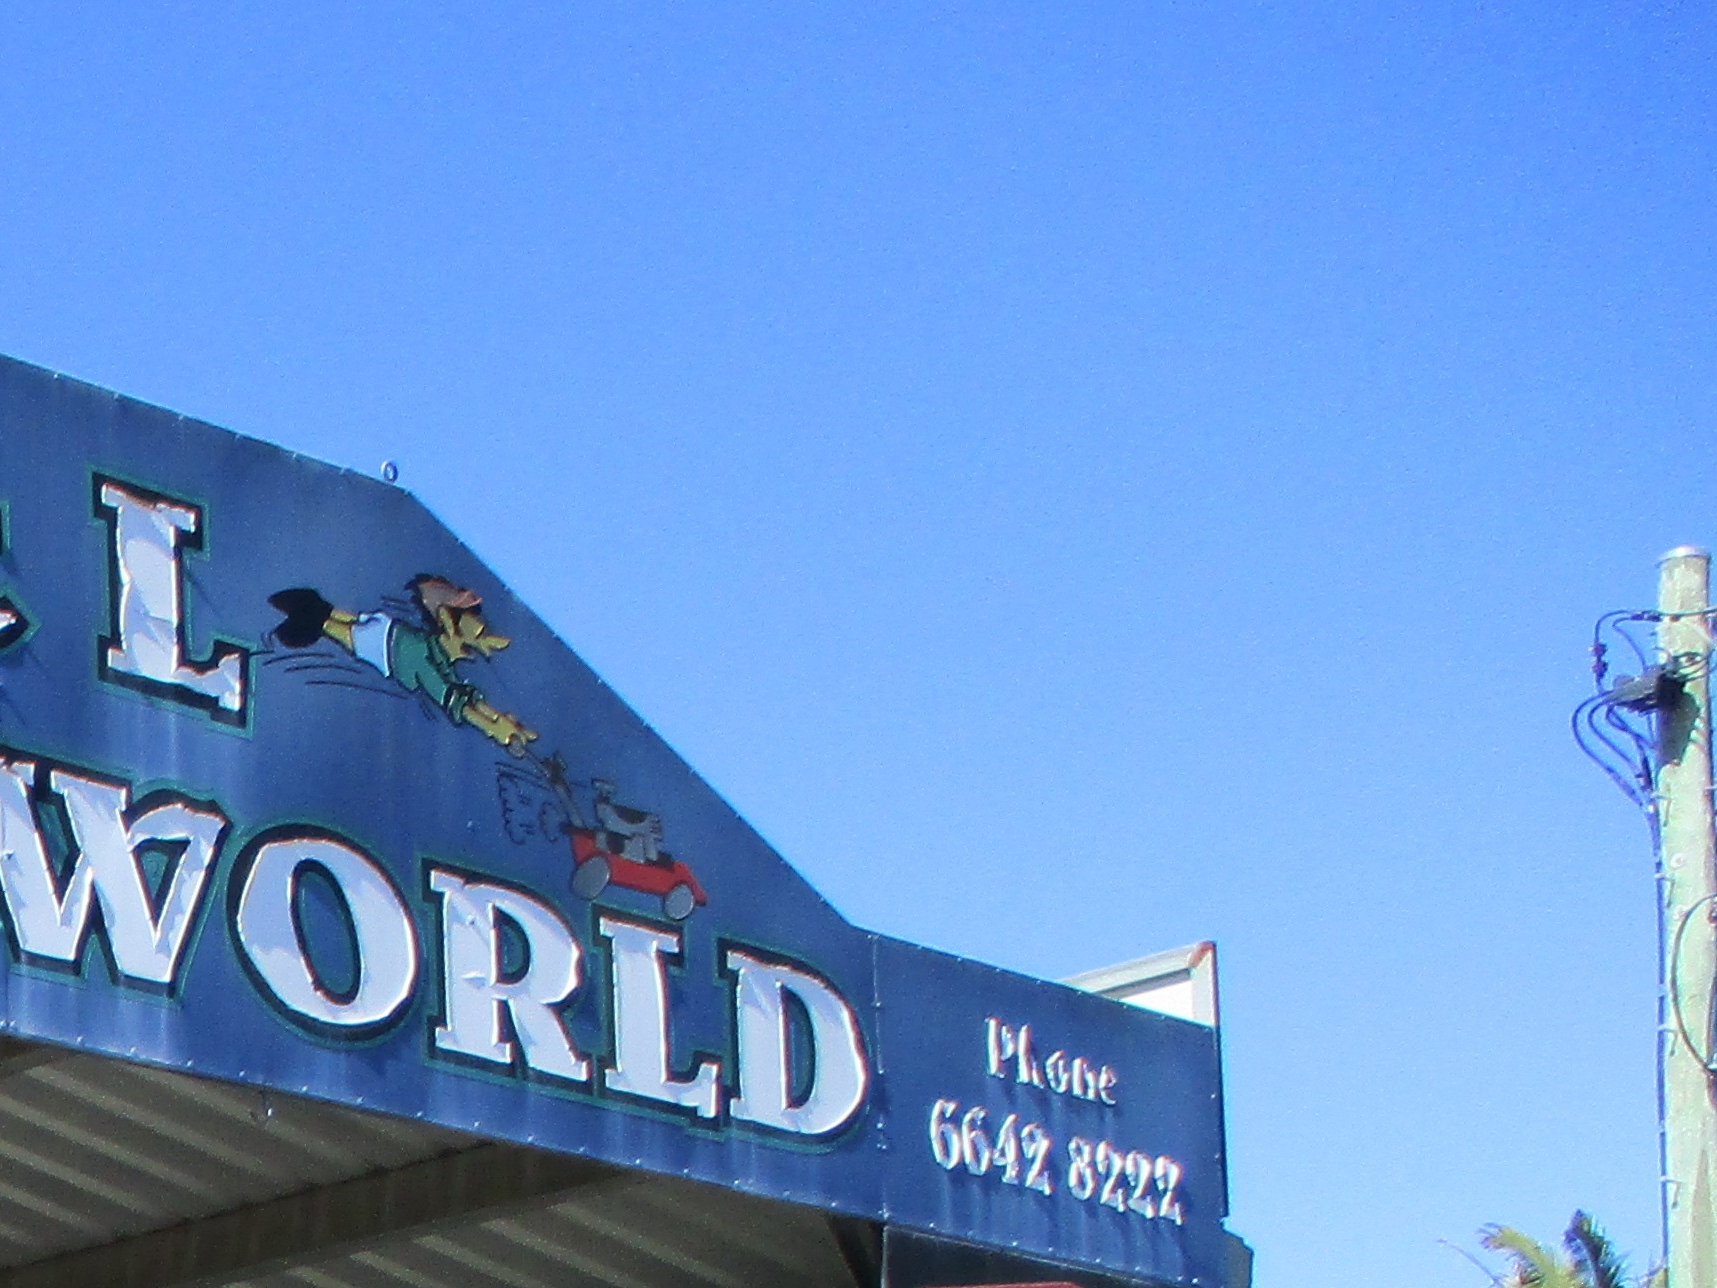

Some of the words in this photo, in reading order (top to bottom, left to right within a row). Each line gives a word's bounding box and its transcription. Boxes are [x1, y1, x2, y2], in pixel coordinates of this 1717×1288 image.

[92, 480, 248, 716] L
[985, 1017, 1118, 1106] Phone
[930, 1098, 1053, 1196] 6642
[1068, 1136, 1183, 1226] 8222
